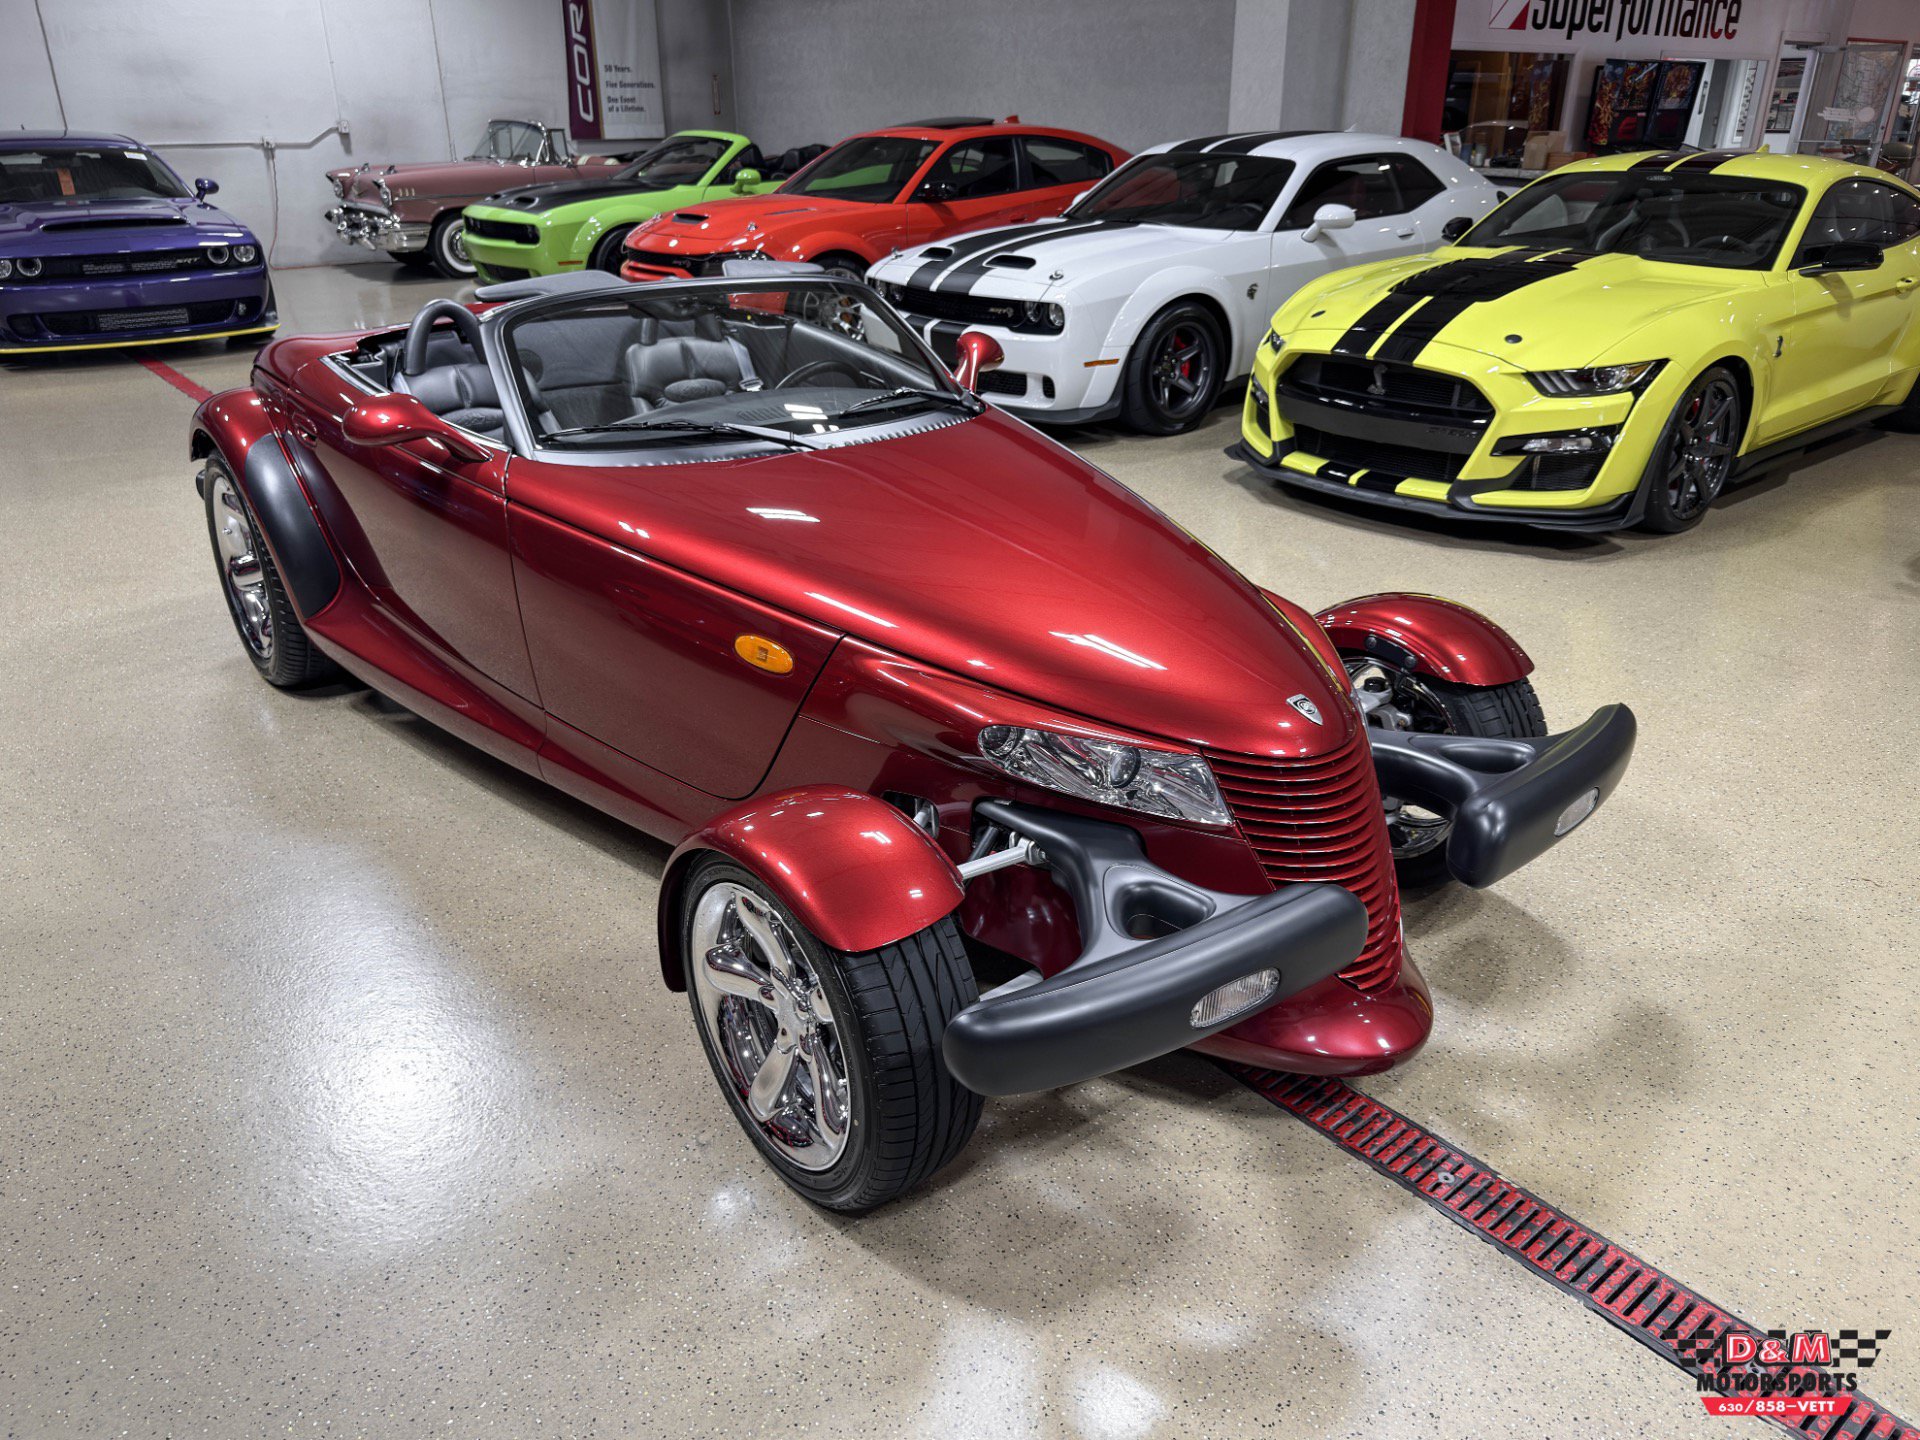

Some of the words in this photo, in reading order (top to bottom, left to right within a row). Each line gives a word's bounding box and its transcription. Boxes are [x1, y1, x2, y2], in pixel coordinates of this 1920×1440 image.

[613, 64, 632, 73] Years.
[605, 80, 618, 89] Five
[619, 80, 656, 89] Generations.
[607, 96, 618, 104] One
[620, 96, 636, 104] Event
[608, 105, 614, 113] of
[621, 105, 646, 113] Lifetime.
